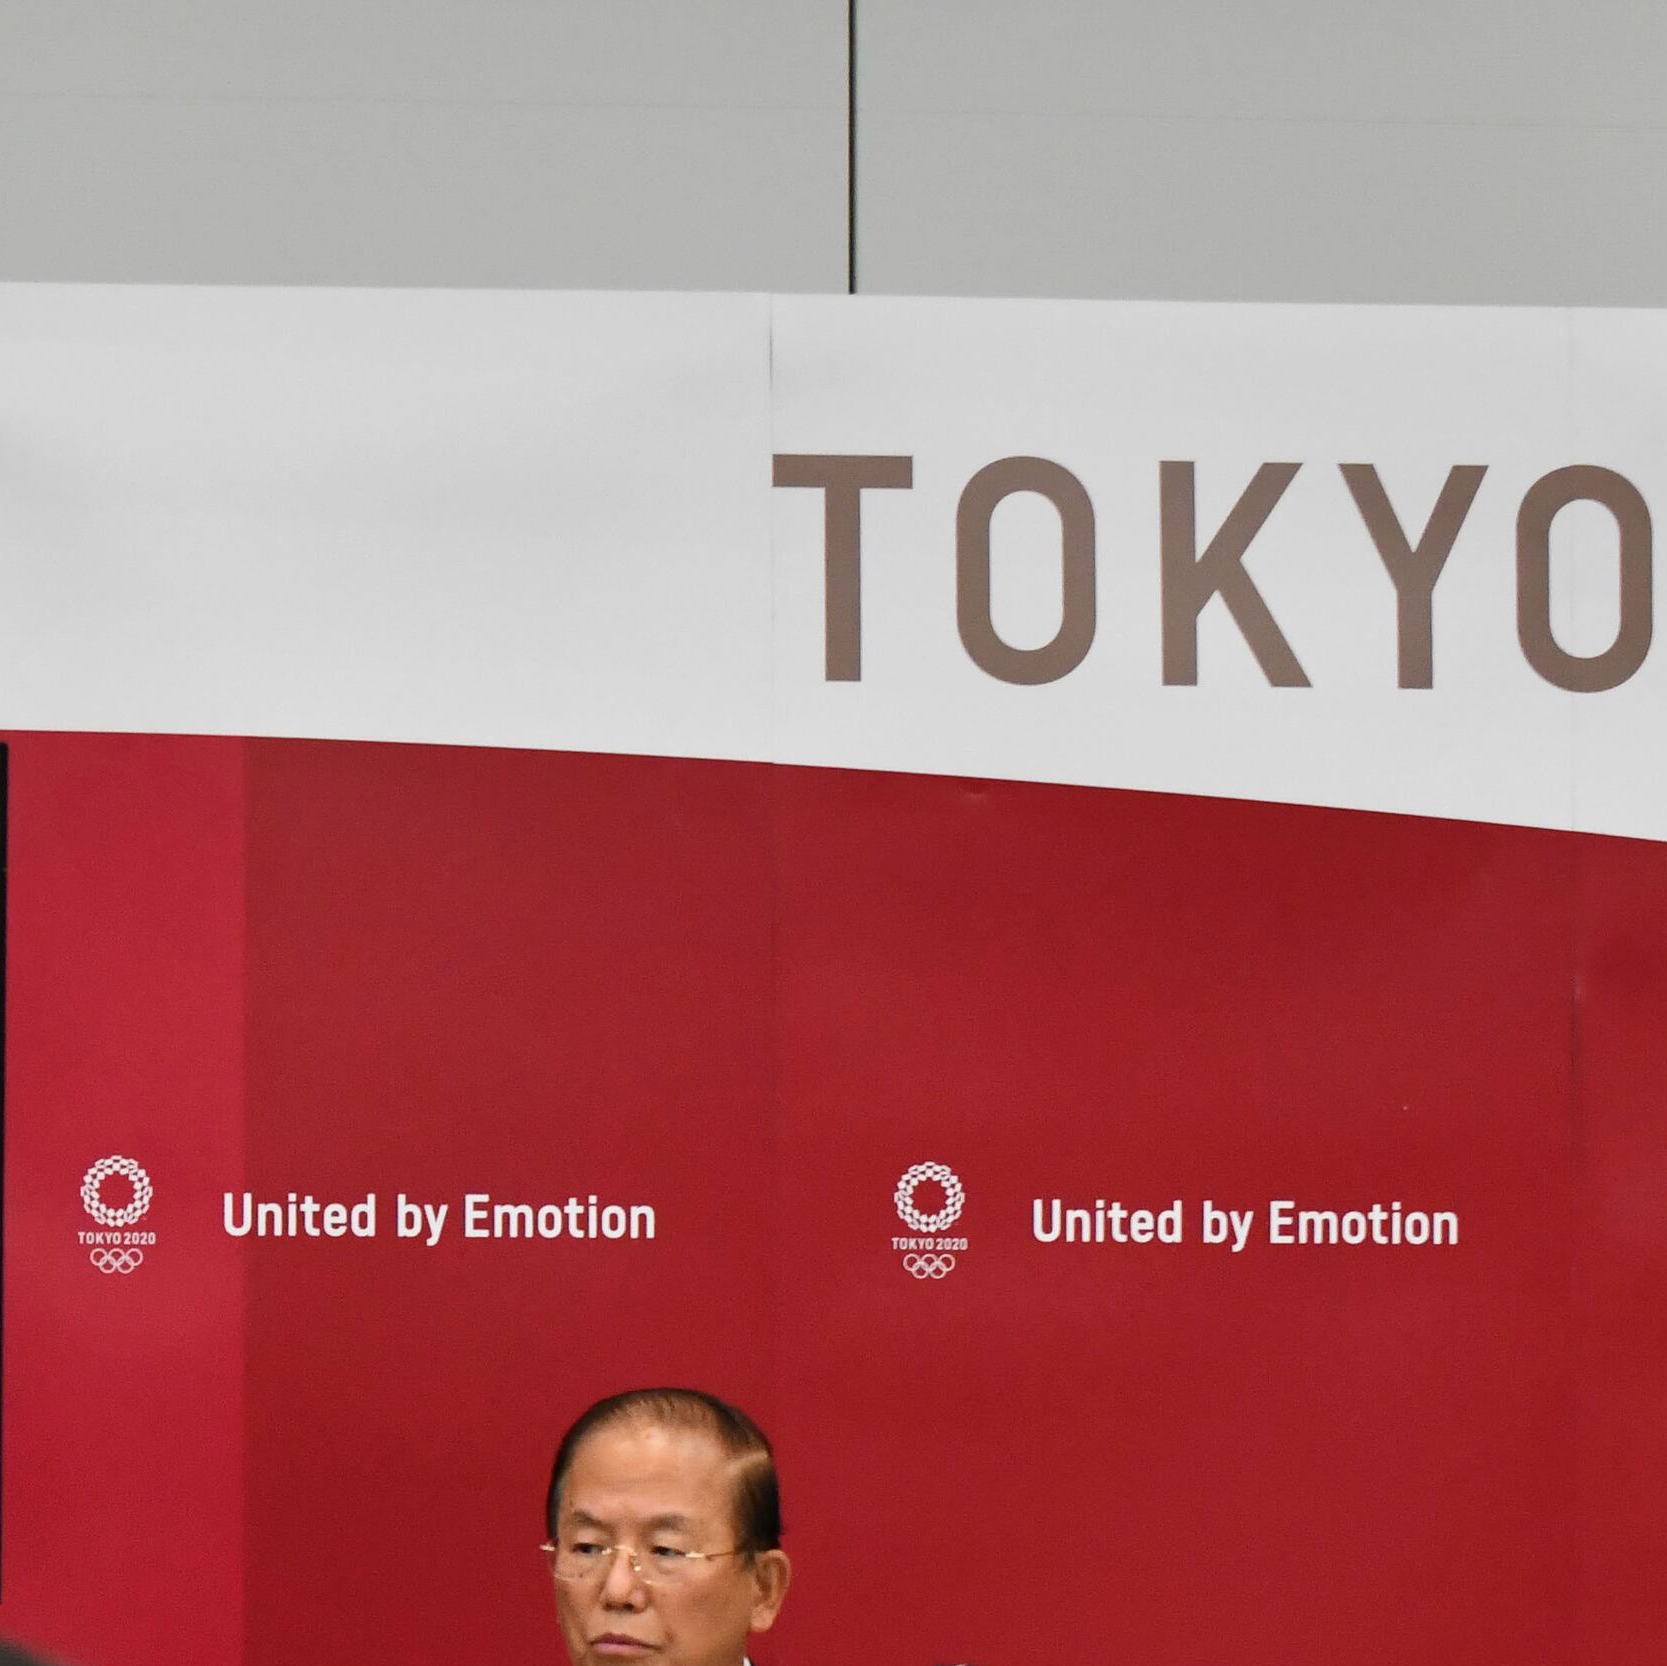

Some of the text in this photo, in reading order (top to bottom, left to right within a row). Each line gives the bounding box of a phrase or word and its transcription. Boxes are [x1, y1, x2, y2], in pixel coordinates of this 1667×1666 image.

[772, 453, 1654, 694] TOKYO
[78, 1231, 157, 1245] TOKYO 2020
[223, 1192, 655, 1247] United by Emotion
[891, 1237, 969, 1251] TOKYO 2020
[1033, 1198, 1458, 1253] United by Emotion
